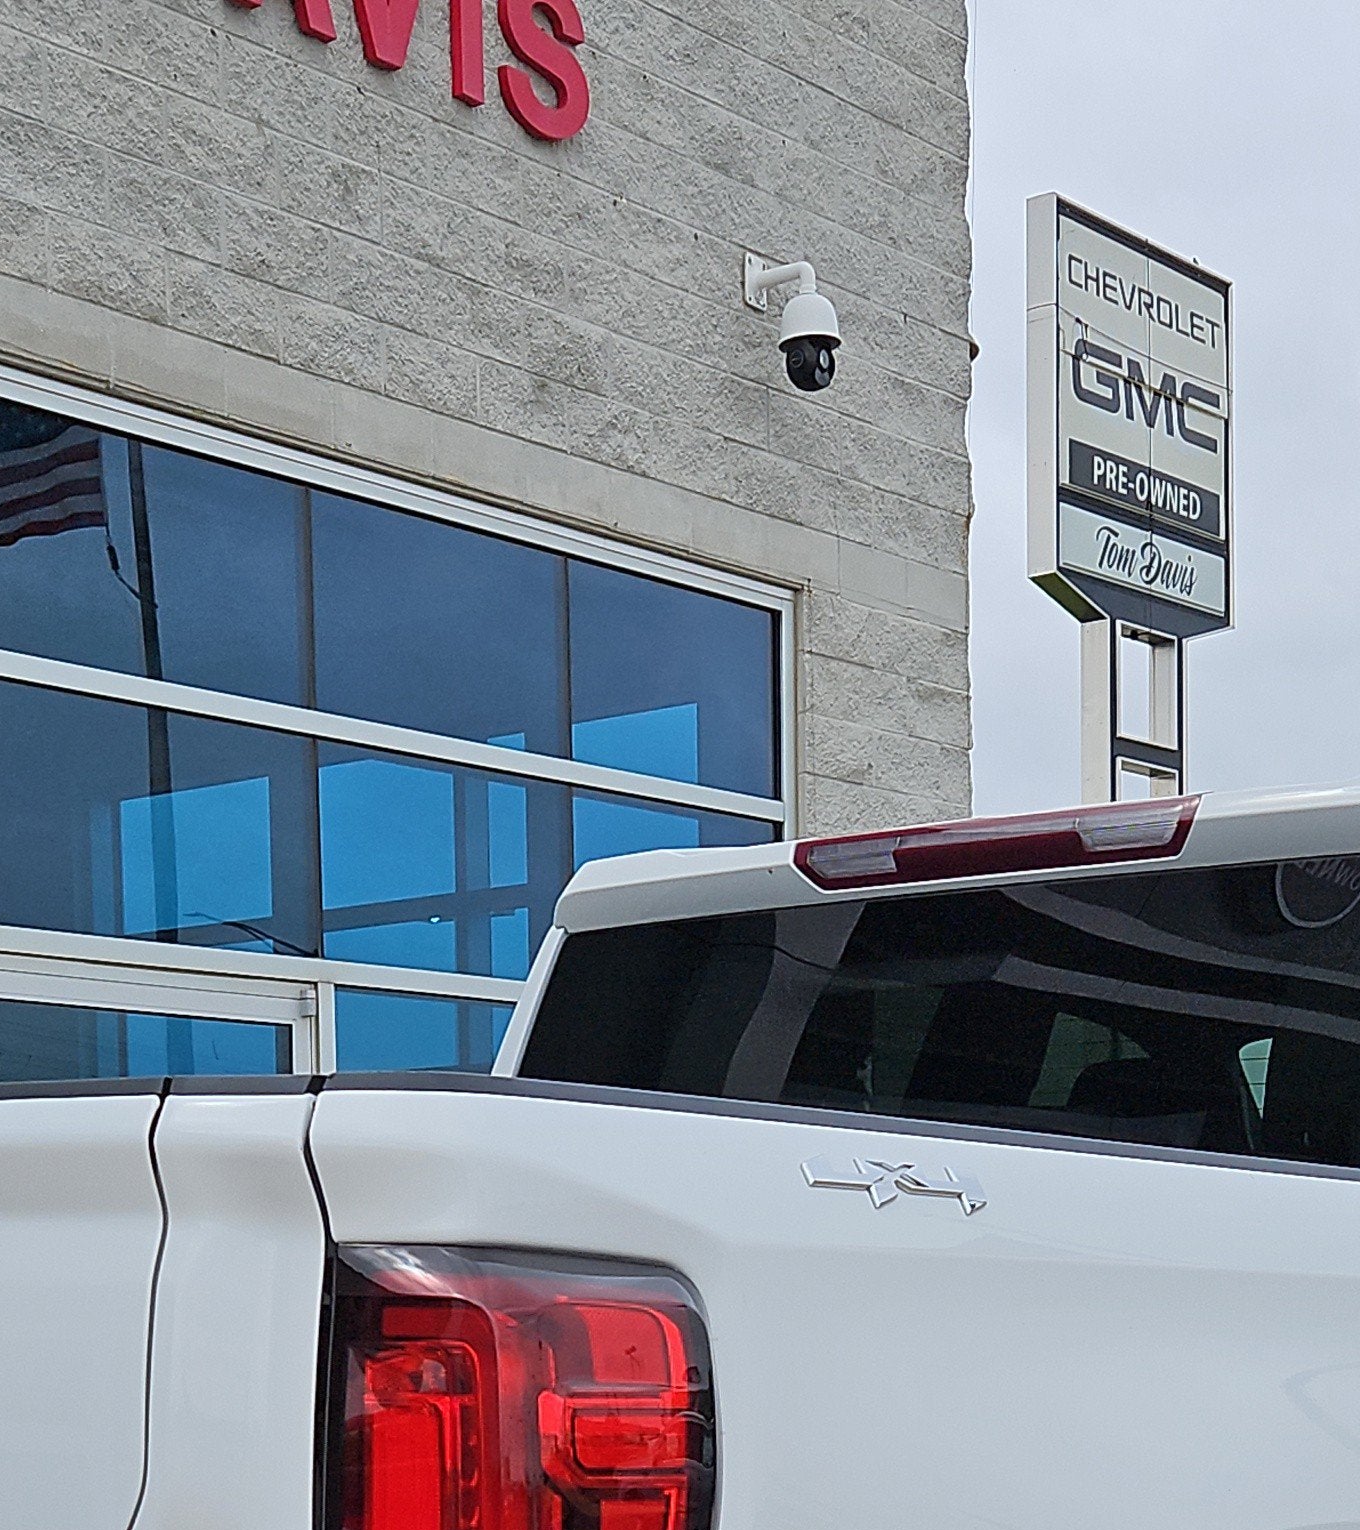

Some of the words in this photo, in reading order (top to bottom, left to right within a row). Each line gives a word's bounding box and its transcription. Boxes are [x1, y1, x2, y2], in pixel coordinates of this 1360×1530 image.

[1068, 253, 1221, 349] CHEVROLET
[1071, 338, 1221, 454] GMC
[1093, 455, 1201, 520] PRE-OWNED
[1095, 526, 1139, 578] Tom
[1140, 541, 1198, 597] Davis
